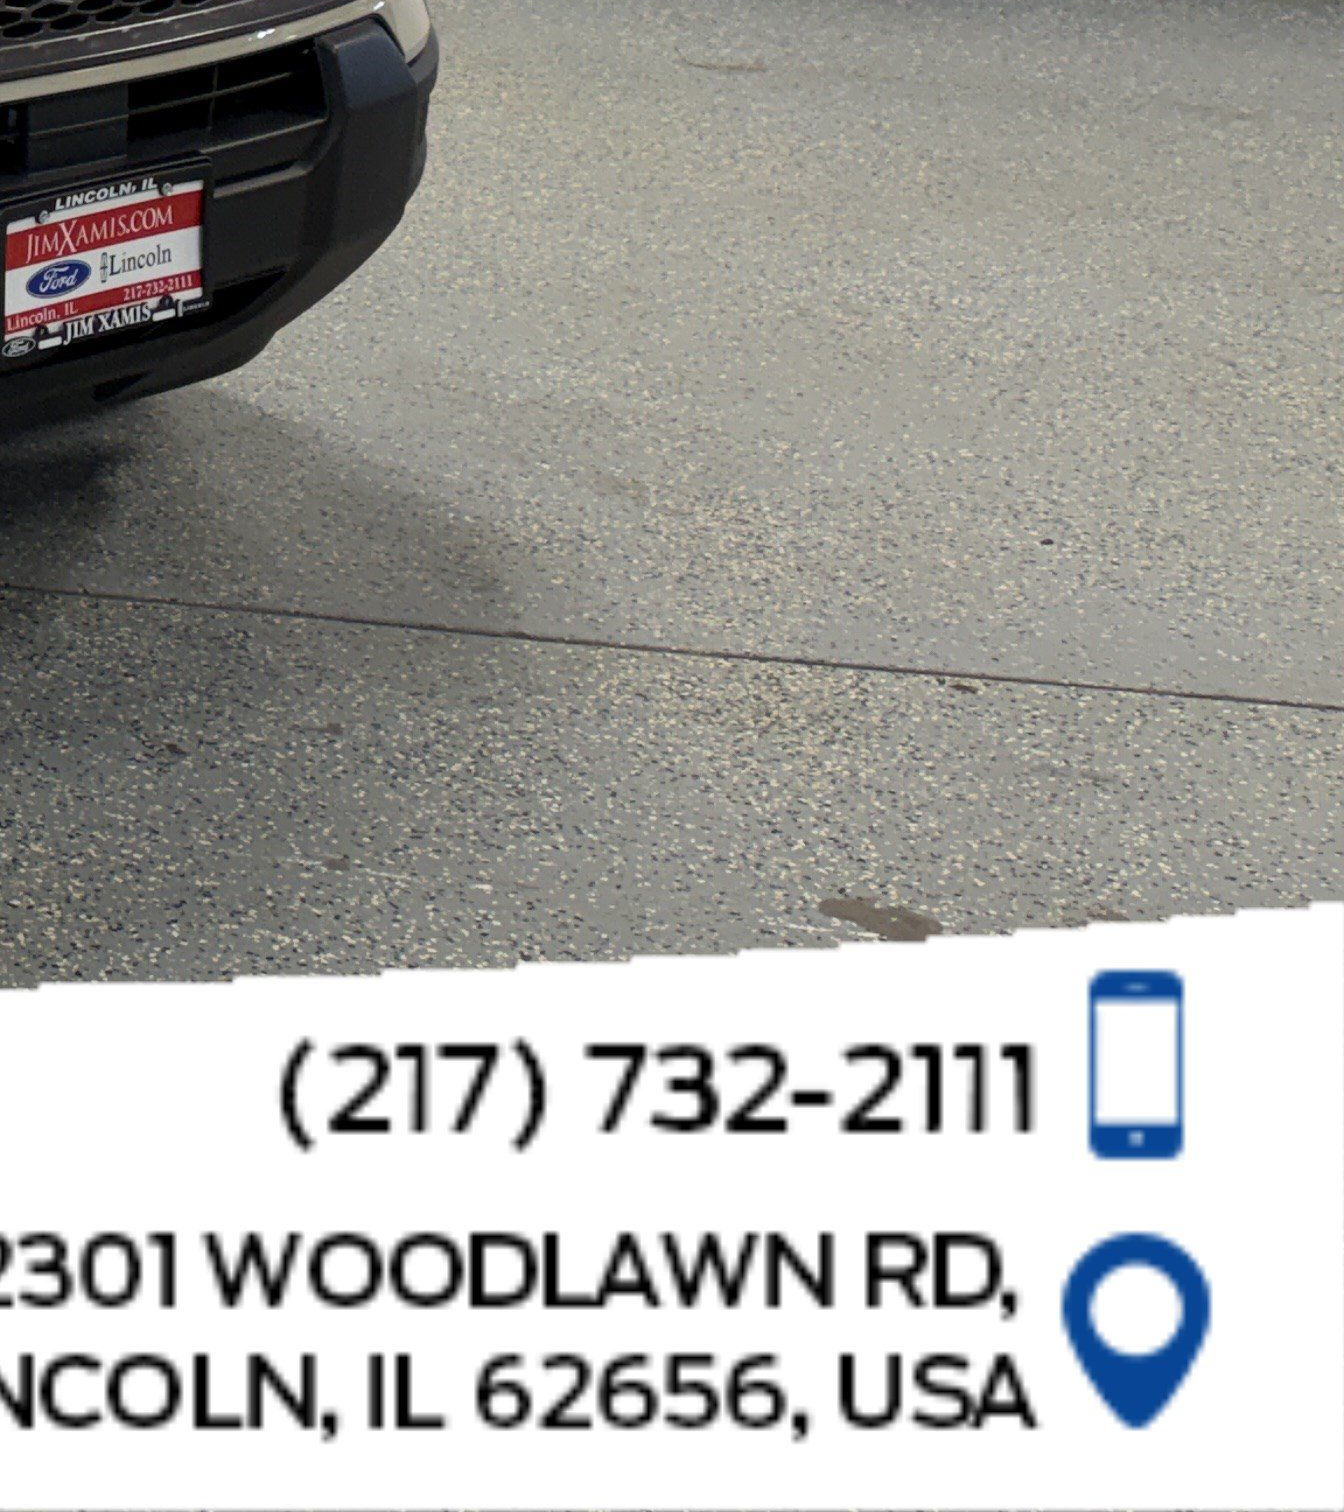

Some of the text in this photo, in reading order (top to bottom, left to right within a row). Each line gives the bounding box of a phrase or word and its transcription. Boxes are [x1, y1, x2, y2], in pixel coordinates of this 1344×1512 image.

[55, 176, 158, 210] LINCOLN, IL
[109, 244, 172, 276] Lincoln
[39, 265, 78, 293] Ford
[123, 274, 193, 302] 217-732-2111
[63, 319, 94, 345] JIM
[99, 302, 151, 332] XAMIS
[64, 301, 78, 316] IL
